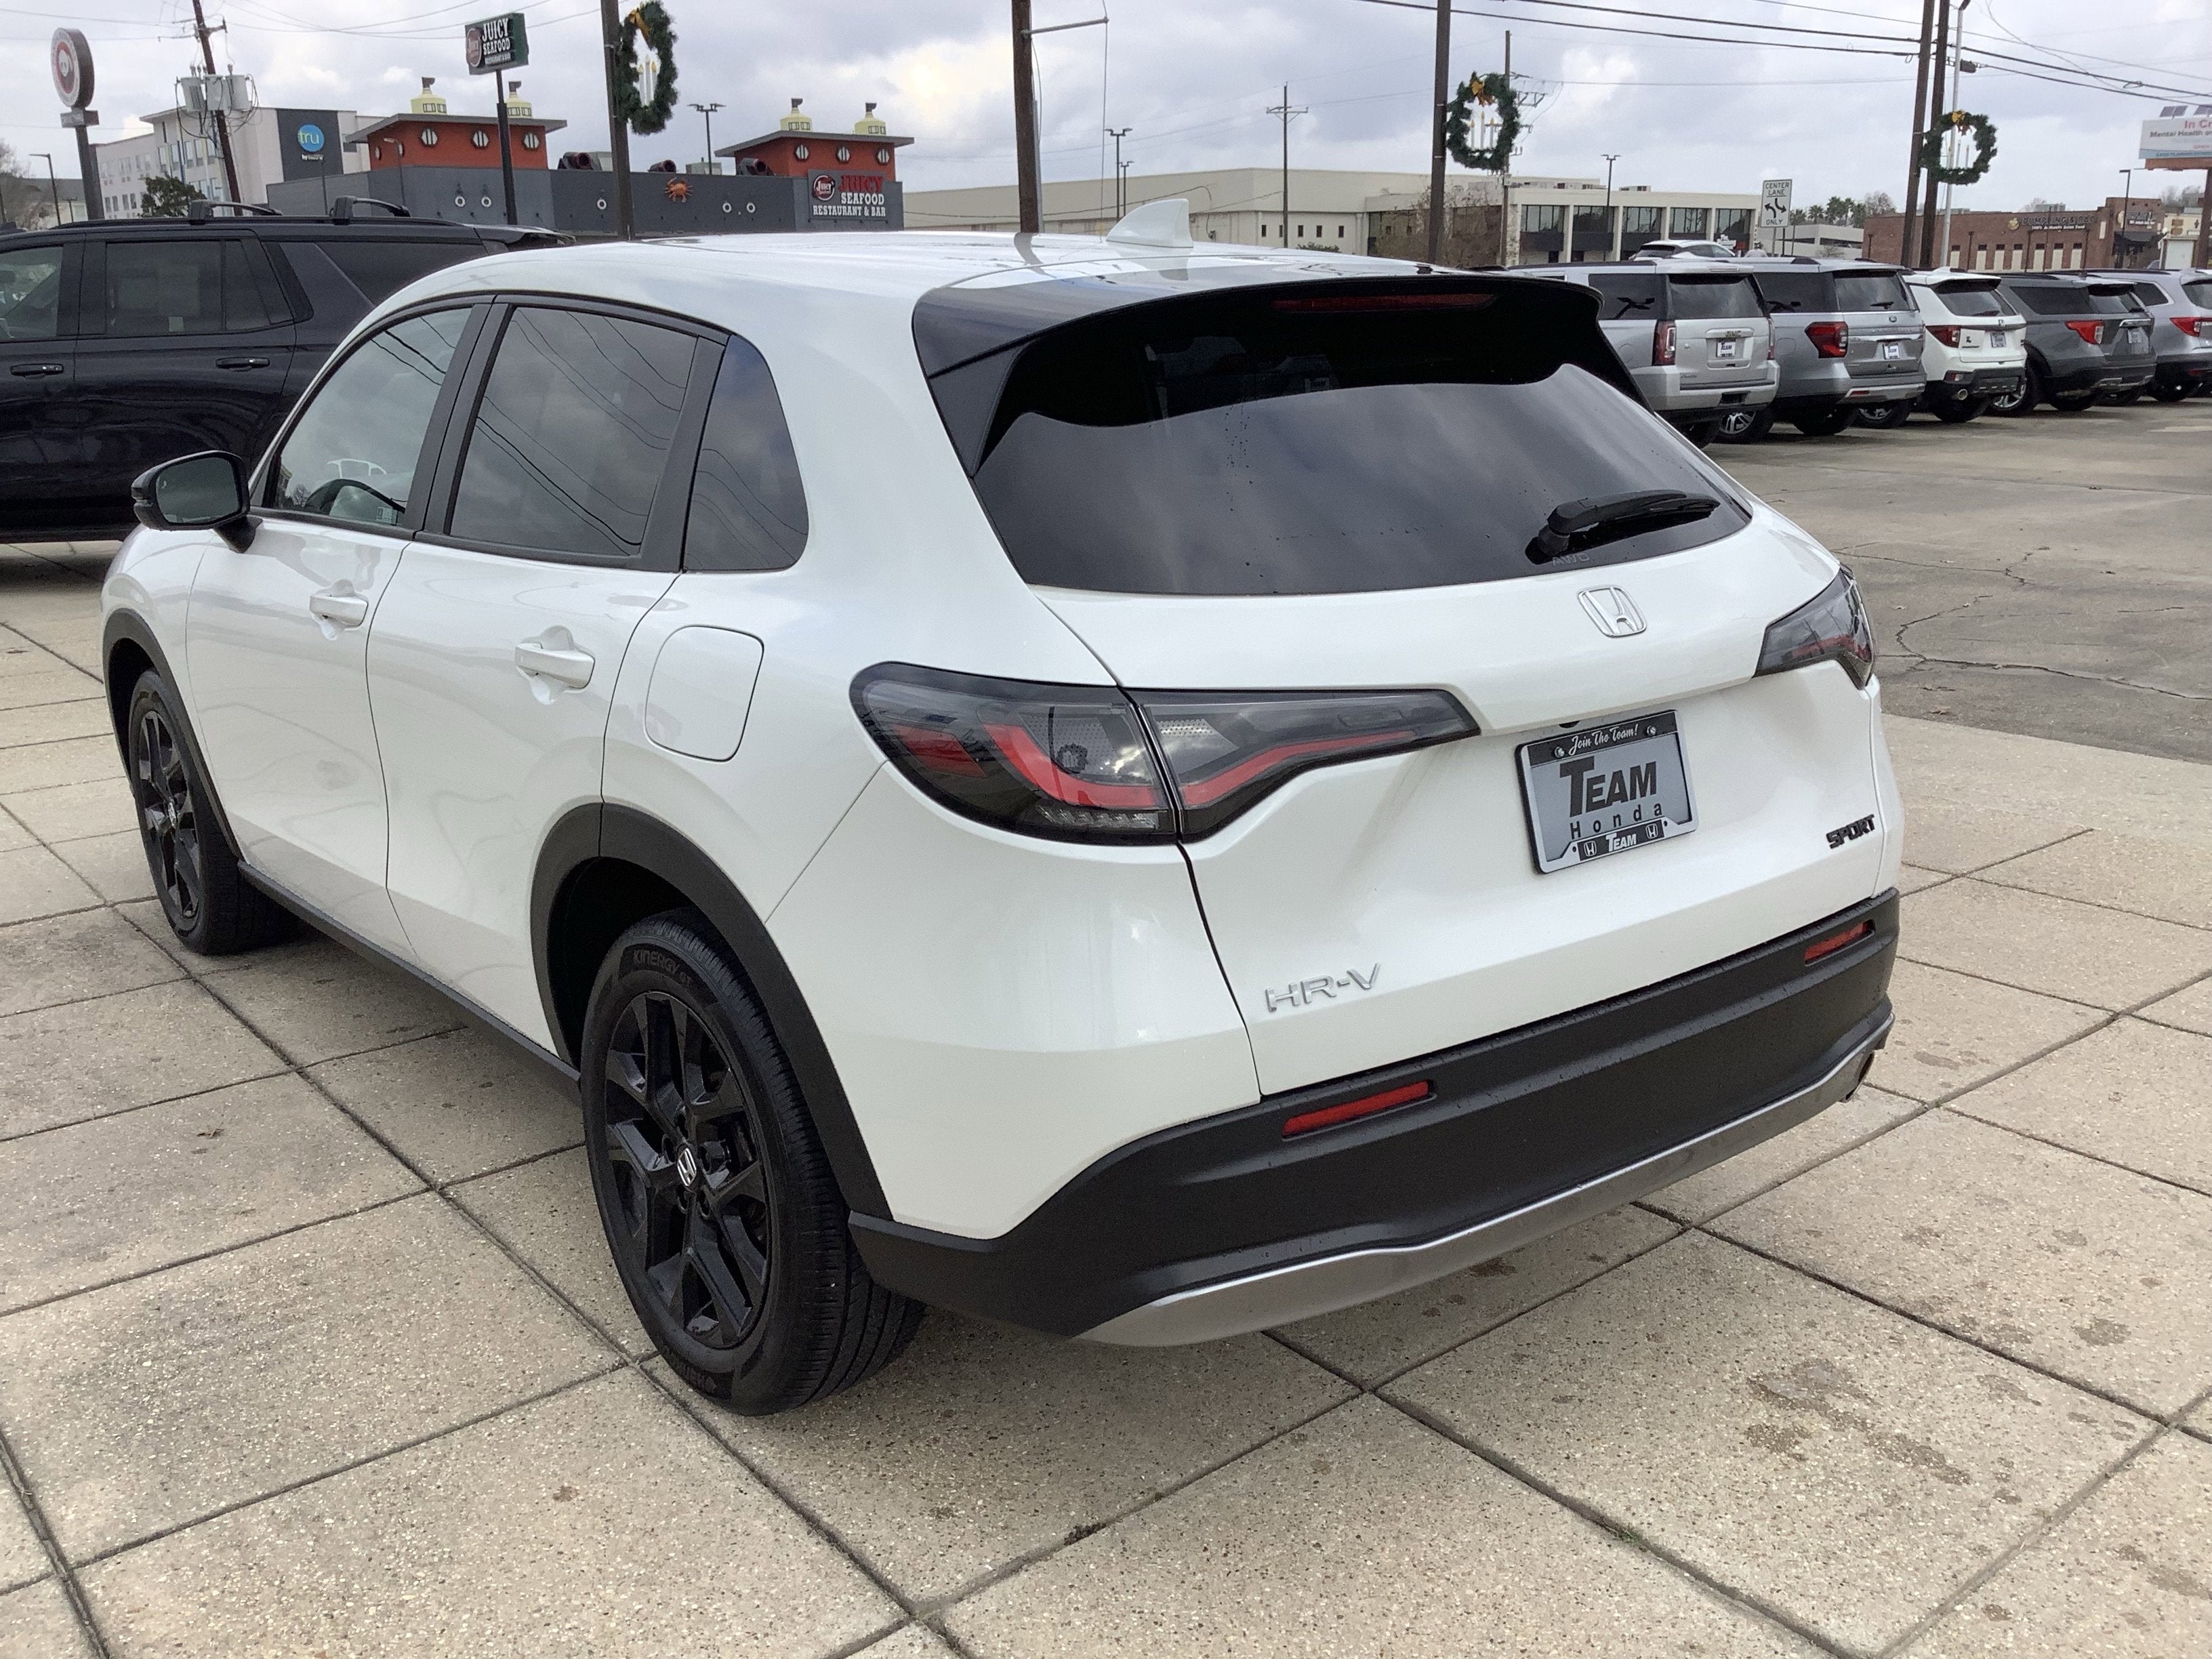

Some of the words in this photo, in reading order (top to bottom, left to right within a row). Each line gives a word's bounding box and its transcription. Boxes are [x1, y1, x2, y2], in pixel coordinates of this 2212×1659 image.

[482, 18, 508, 41] JUICY
[483, 37, 510, 55] SEAFOOD
[298, 130, 320, 144] tru
[838, 174, 883, 192] JUICY
[841, 192, 884, 205] SEAFOOD
[813, 205, 862, 216] RESTAURANT
[863, 206, 869, 216] &
[871, 207, 886, 217] BAR
[1568, 735, 1592, 756] Join
[1592, 731, 1610, 745] The
[1610, 723, 1639, 744] Team!
[1559, 755, 1657, 817] TEAM
[1570, 802, 1663, 840] Honda
[1826, 814, 1875, 849] SPORT
[1605, 832, 1637, 852] TEAM
[1265, 962, 1382, 1013] HR-V
